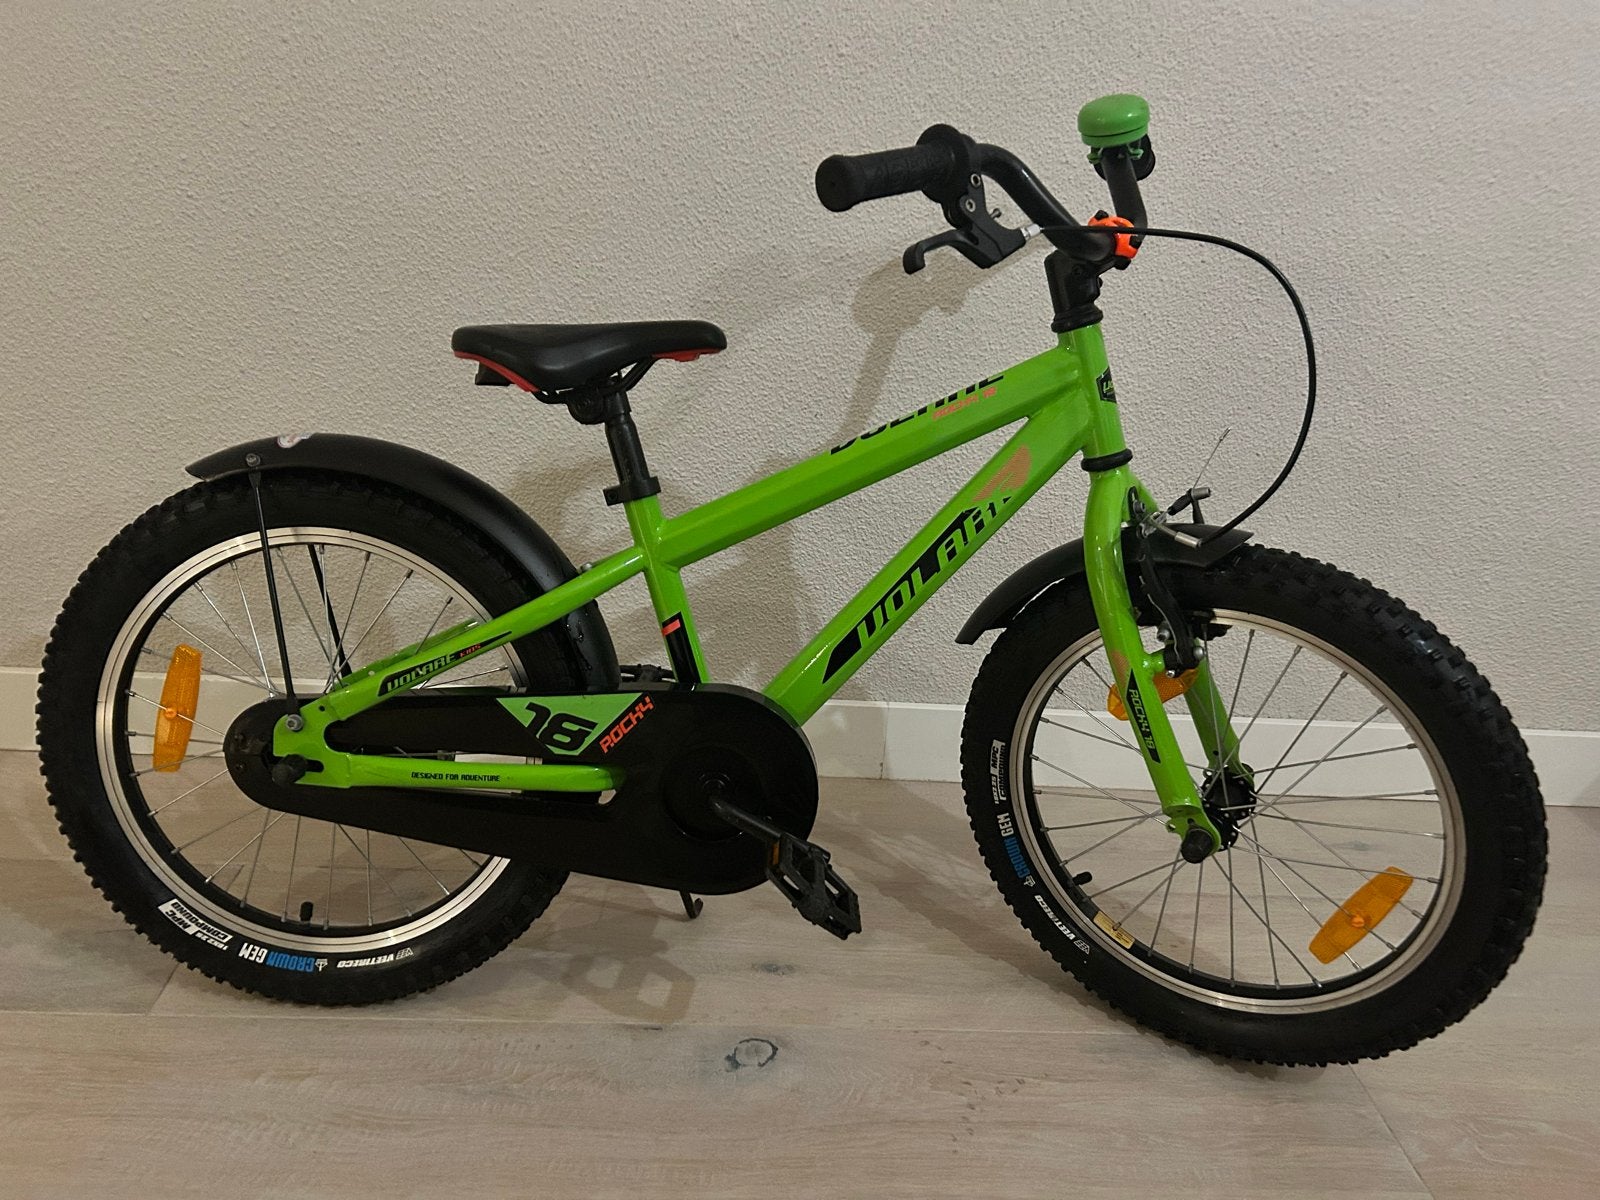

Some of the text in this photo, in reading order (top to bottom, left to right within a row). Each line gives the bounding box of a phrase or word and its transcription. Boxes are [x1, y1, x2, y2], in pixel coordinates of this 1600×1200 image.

[599, 696, 654, 754] ROCKY
[991, 745, 999, 769] MPC
[411, 771, 500, 782] DESIGNED FOR ADVENTURE
[996, 812, 1030, 879] CROWN GEM
[165, 909, 191, 930] MPC
[171, 901, 228, 940] COMPOUND
[238, 942, 315, 973] CROWN GEM
